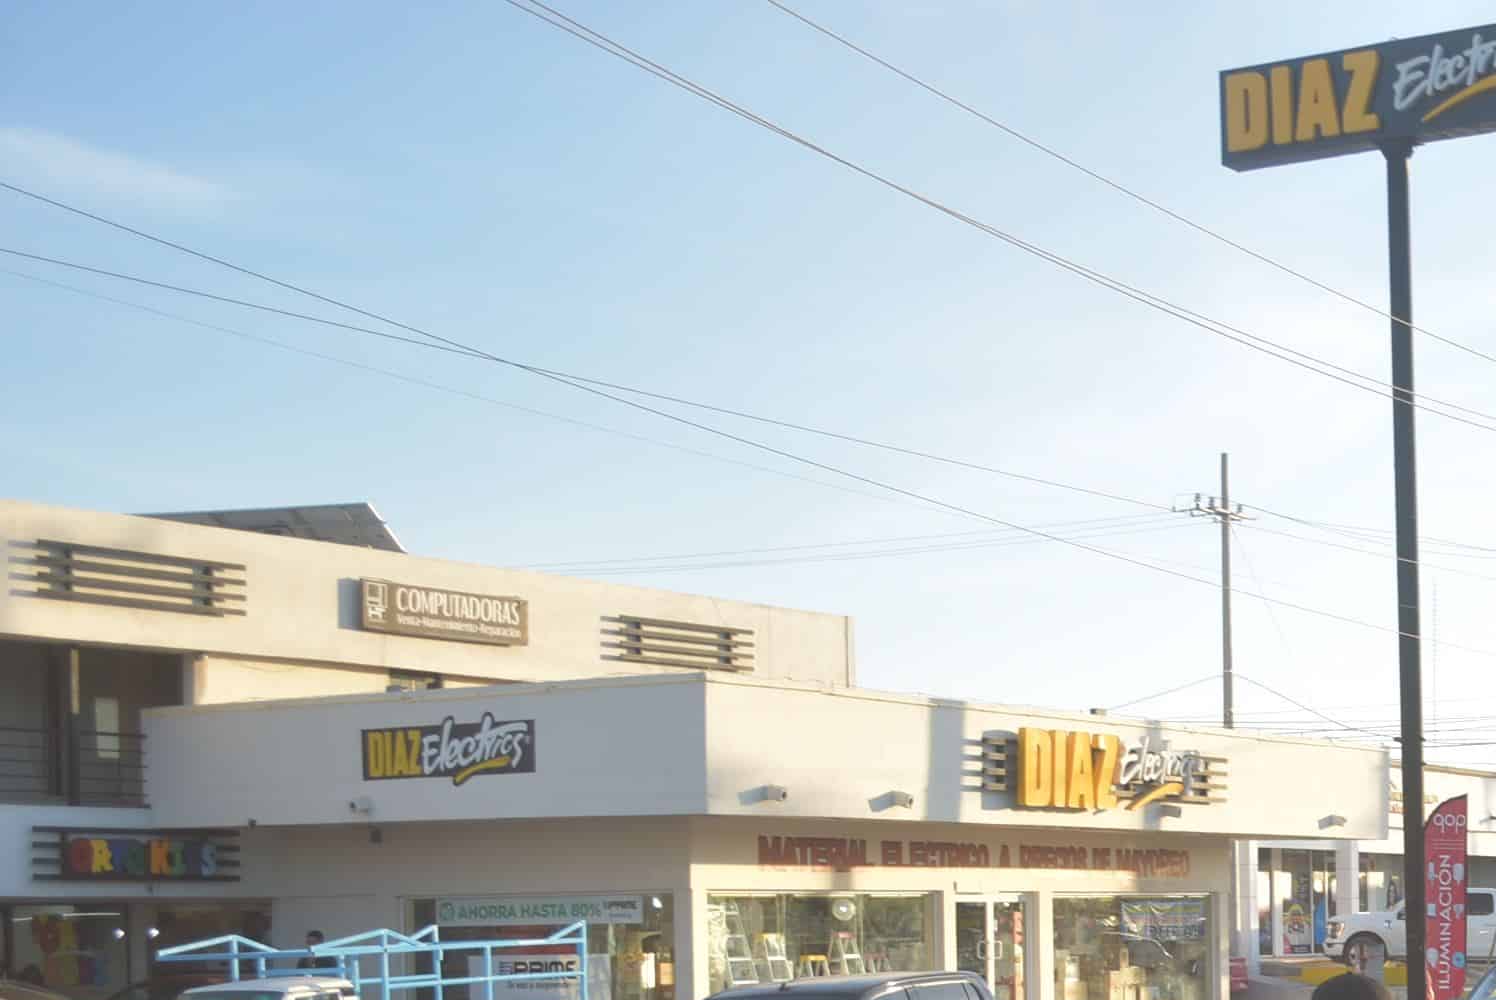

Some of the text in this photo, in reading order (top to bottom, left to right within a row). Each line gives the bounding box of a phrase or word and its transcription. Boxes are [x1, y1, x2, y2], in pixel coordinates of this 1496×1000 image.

[1224, 50, 1381, 153] DIAZ
[396, 587, 521, 626] COMPUTADORAS
[367, 715, 527, 777] DIAZ Electrics
[1017, 727, 1121, 809] DIAZ
[457, 904, 516, 922] AHORRA
[521, 904, 567, 920] HASTA
